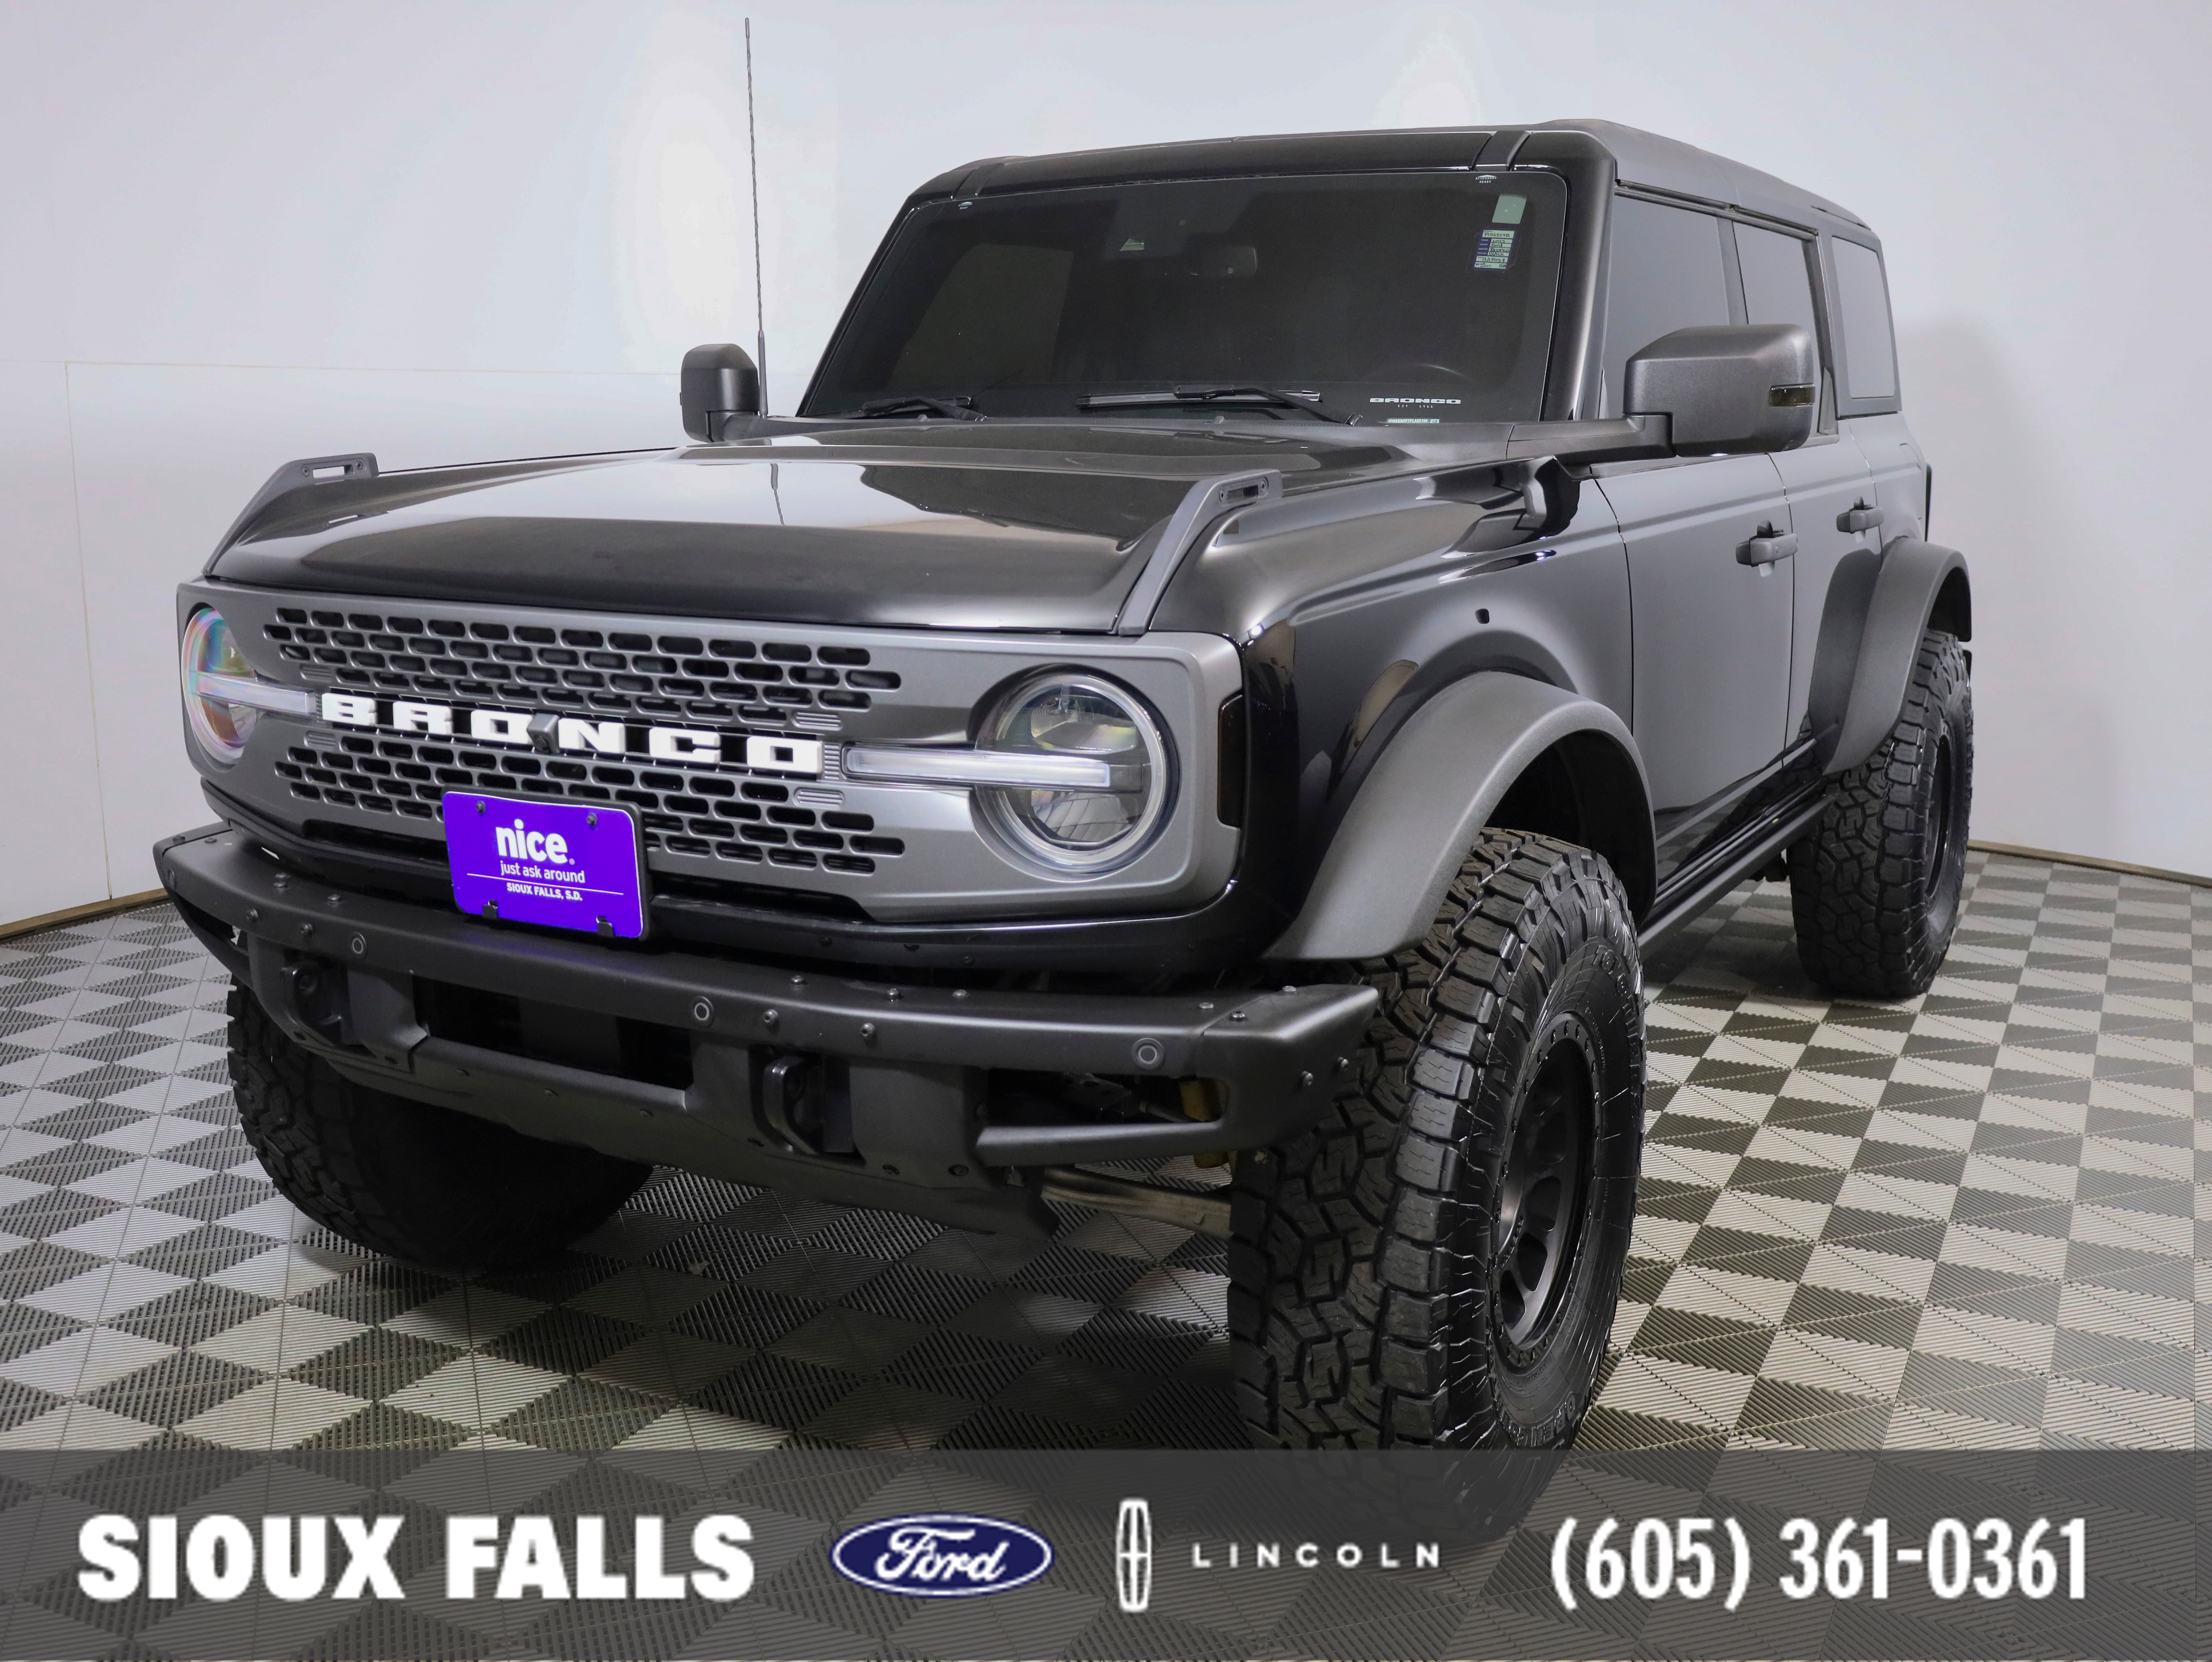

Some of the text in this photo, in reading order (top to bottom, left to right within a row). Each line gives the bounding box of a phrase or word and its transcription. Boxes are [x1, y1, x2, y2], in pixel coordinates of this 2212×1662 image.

[321, 692, 823, 775] BRONCO
[500, 860, 586, 883] just ask around
[507, 882, 583, 901] SIOUX FALLS, S.D.
[1591, 944, 1630, 997] TOYO
